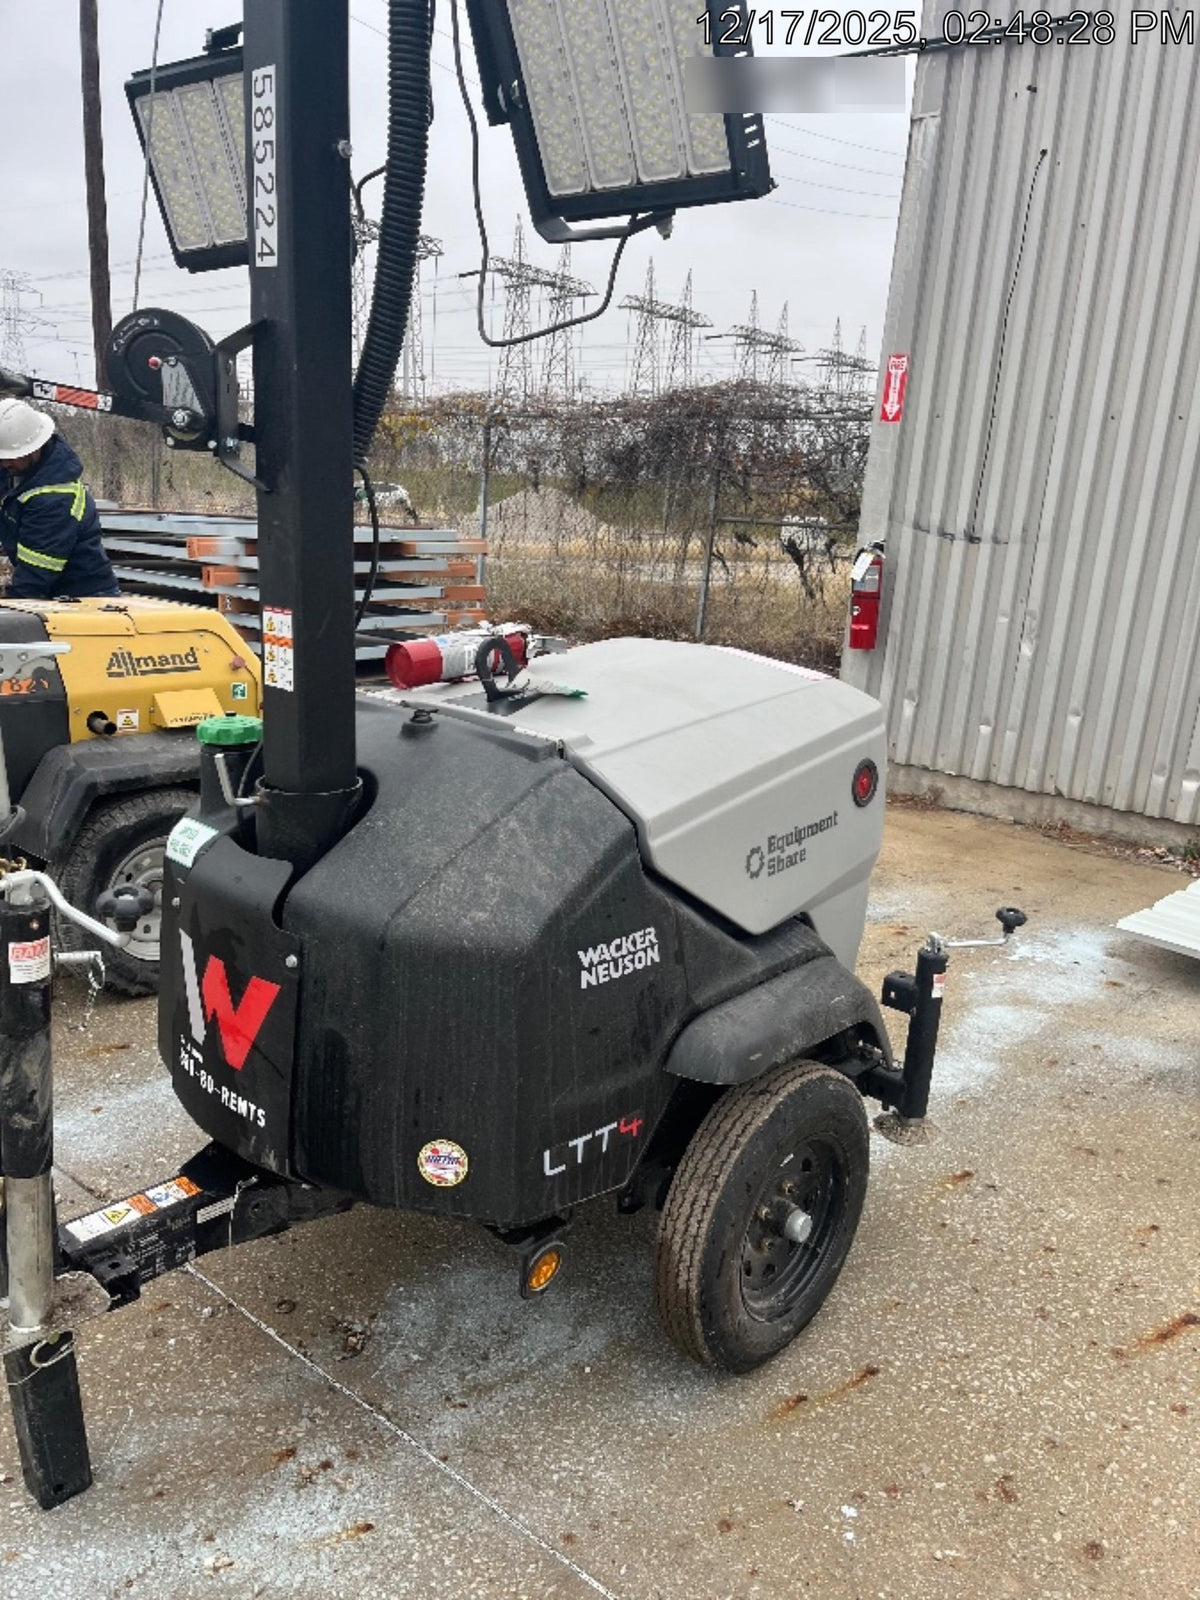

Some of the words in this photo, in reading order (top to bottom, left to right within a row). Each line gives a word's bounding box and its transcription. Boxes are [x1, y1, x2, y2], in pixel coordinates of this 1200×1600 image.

[253, 73, 276, 262] 5852224
[767, 810, 838, 855] Equipment
[767, 848, 806, 877] Share
[577, 926, 658, 968] WACKER
[580, 943, 660, 989] NEUSON
